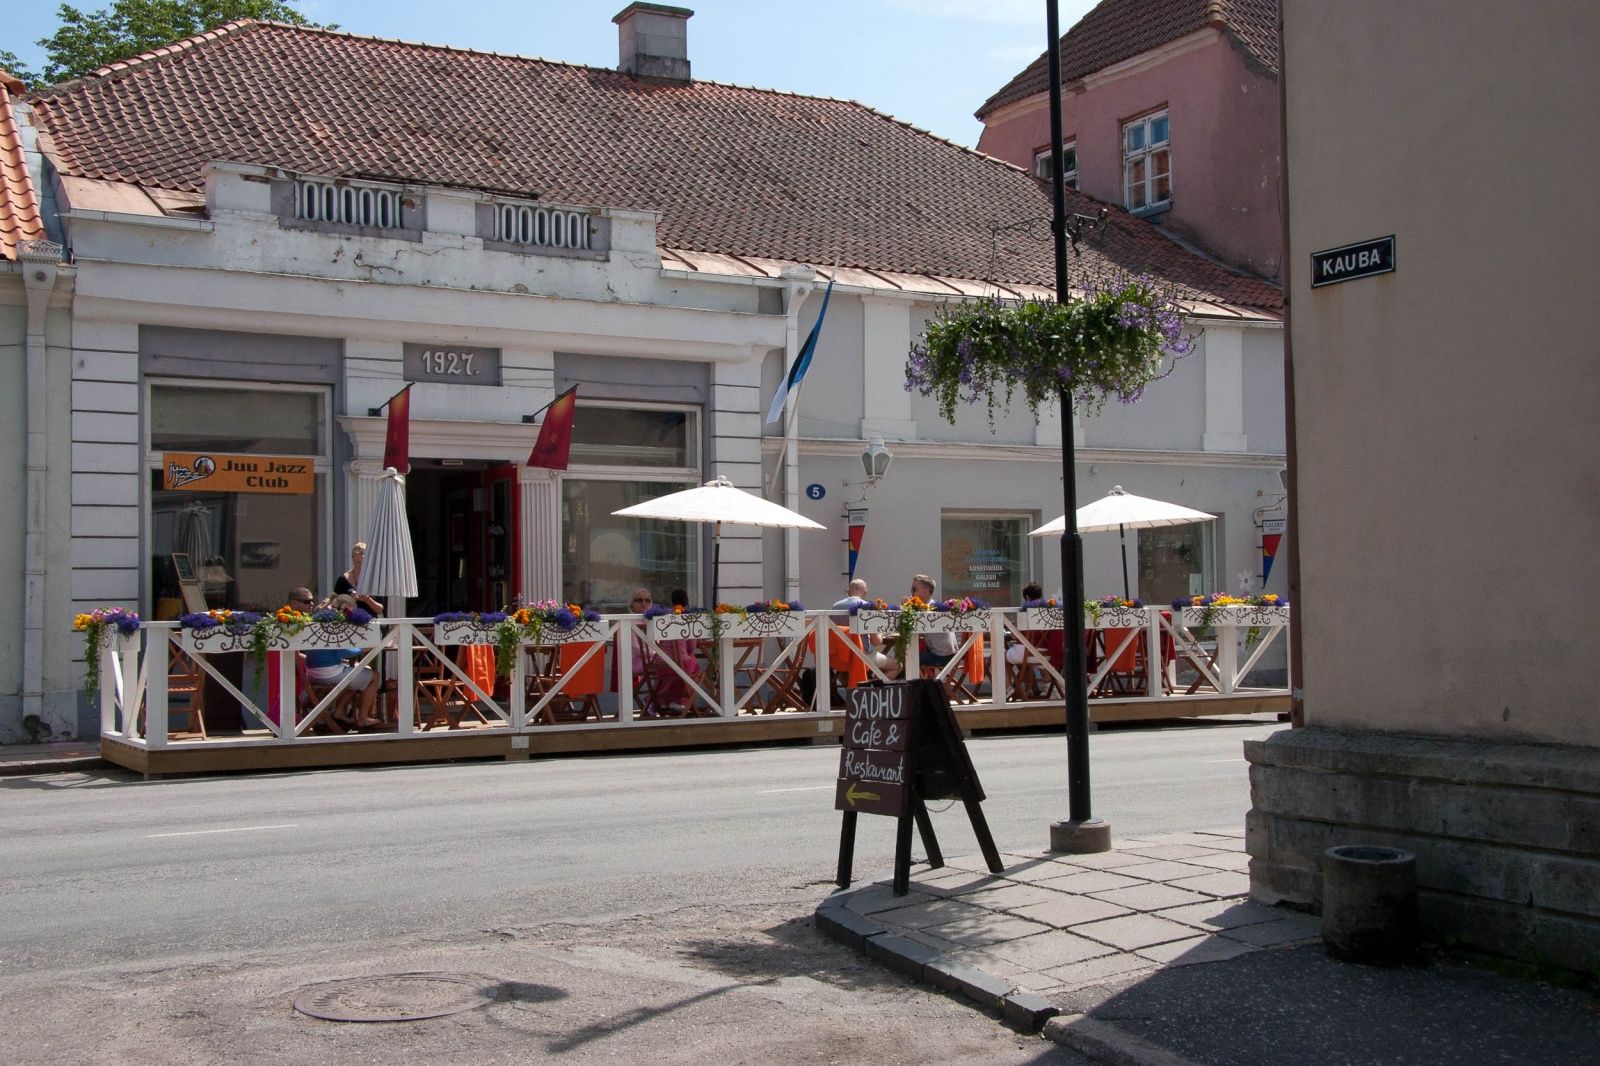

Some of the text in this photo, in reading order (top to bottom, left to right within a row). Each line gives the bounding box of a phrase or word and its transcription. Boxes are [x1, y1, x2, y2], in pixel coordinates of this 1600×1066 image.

[1322, 249, 1380, 276] KAUBA
[222, 460, 306, 474] Juu Jazz
[246, 475, 289, 488] Club
[812, 486, 820, 498] 5
[849, 687, 902, 719] SADHU
[852, 721, 900, 748] Cafe &
[845, 751, 904, 783] Restaurant
